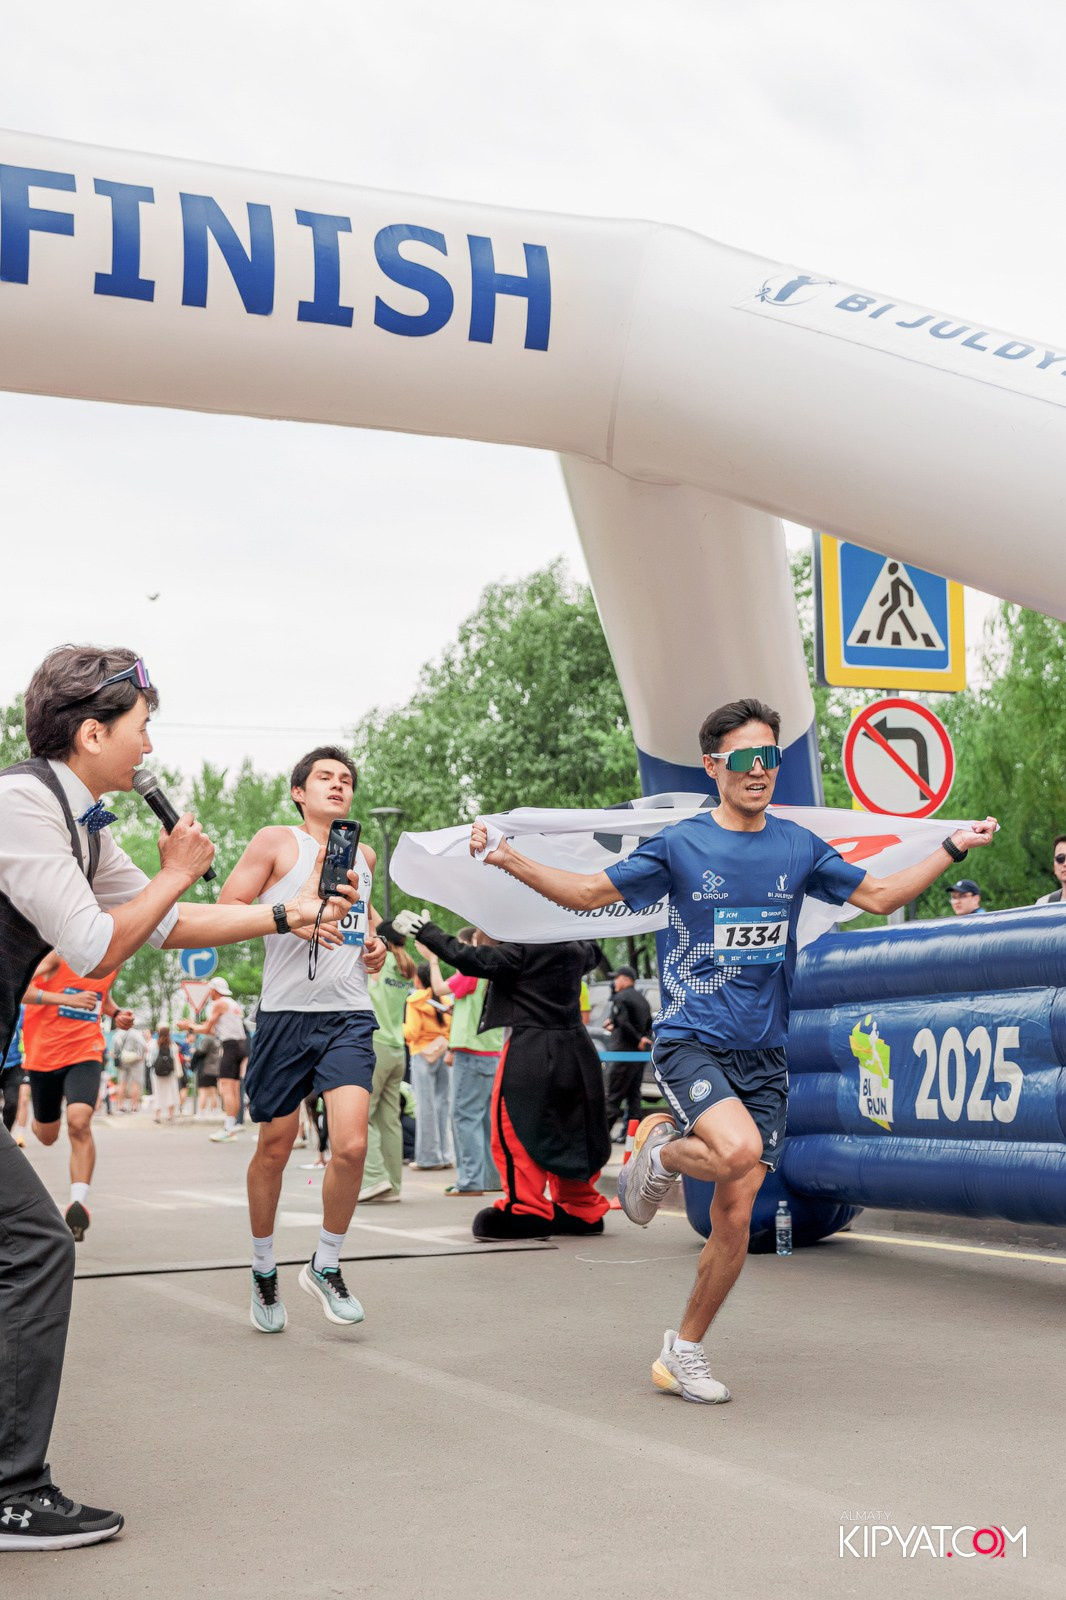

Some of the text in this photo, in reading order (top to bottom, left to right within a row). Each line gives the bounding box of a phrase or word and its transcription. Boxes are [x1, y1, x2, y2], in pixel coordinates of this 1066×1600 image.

[0, 163, 552, 352] FINISH
[834, 293, 1066, 377] BI JULDY
[702, 892, 729, 900] GROUP
[718, 911, 725, 919] 5
[726, 924, 782, 947] 1334
[912, 1025, 1024, 1124] 2025
[863, 1078, 871, 1096] BI
[866, 1097, 887, 1116] RUN
